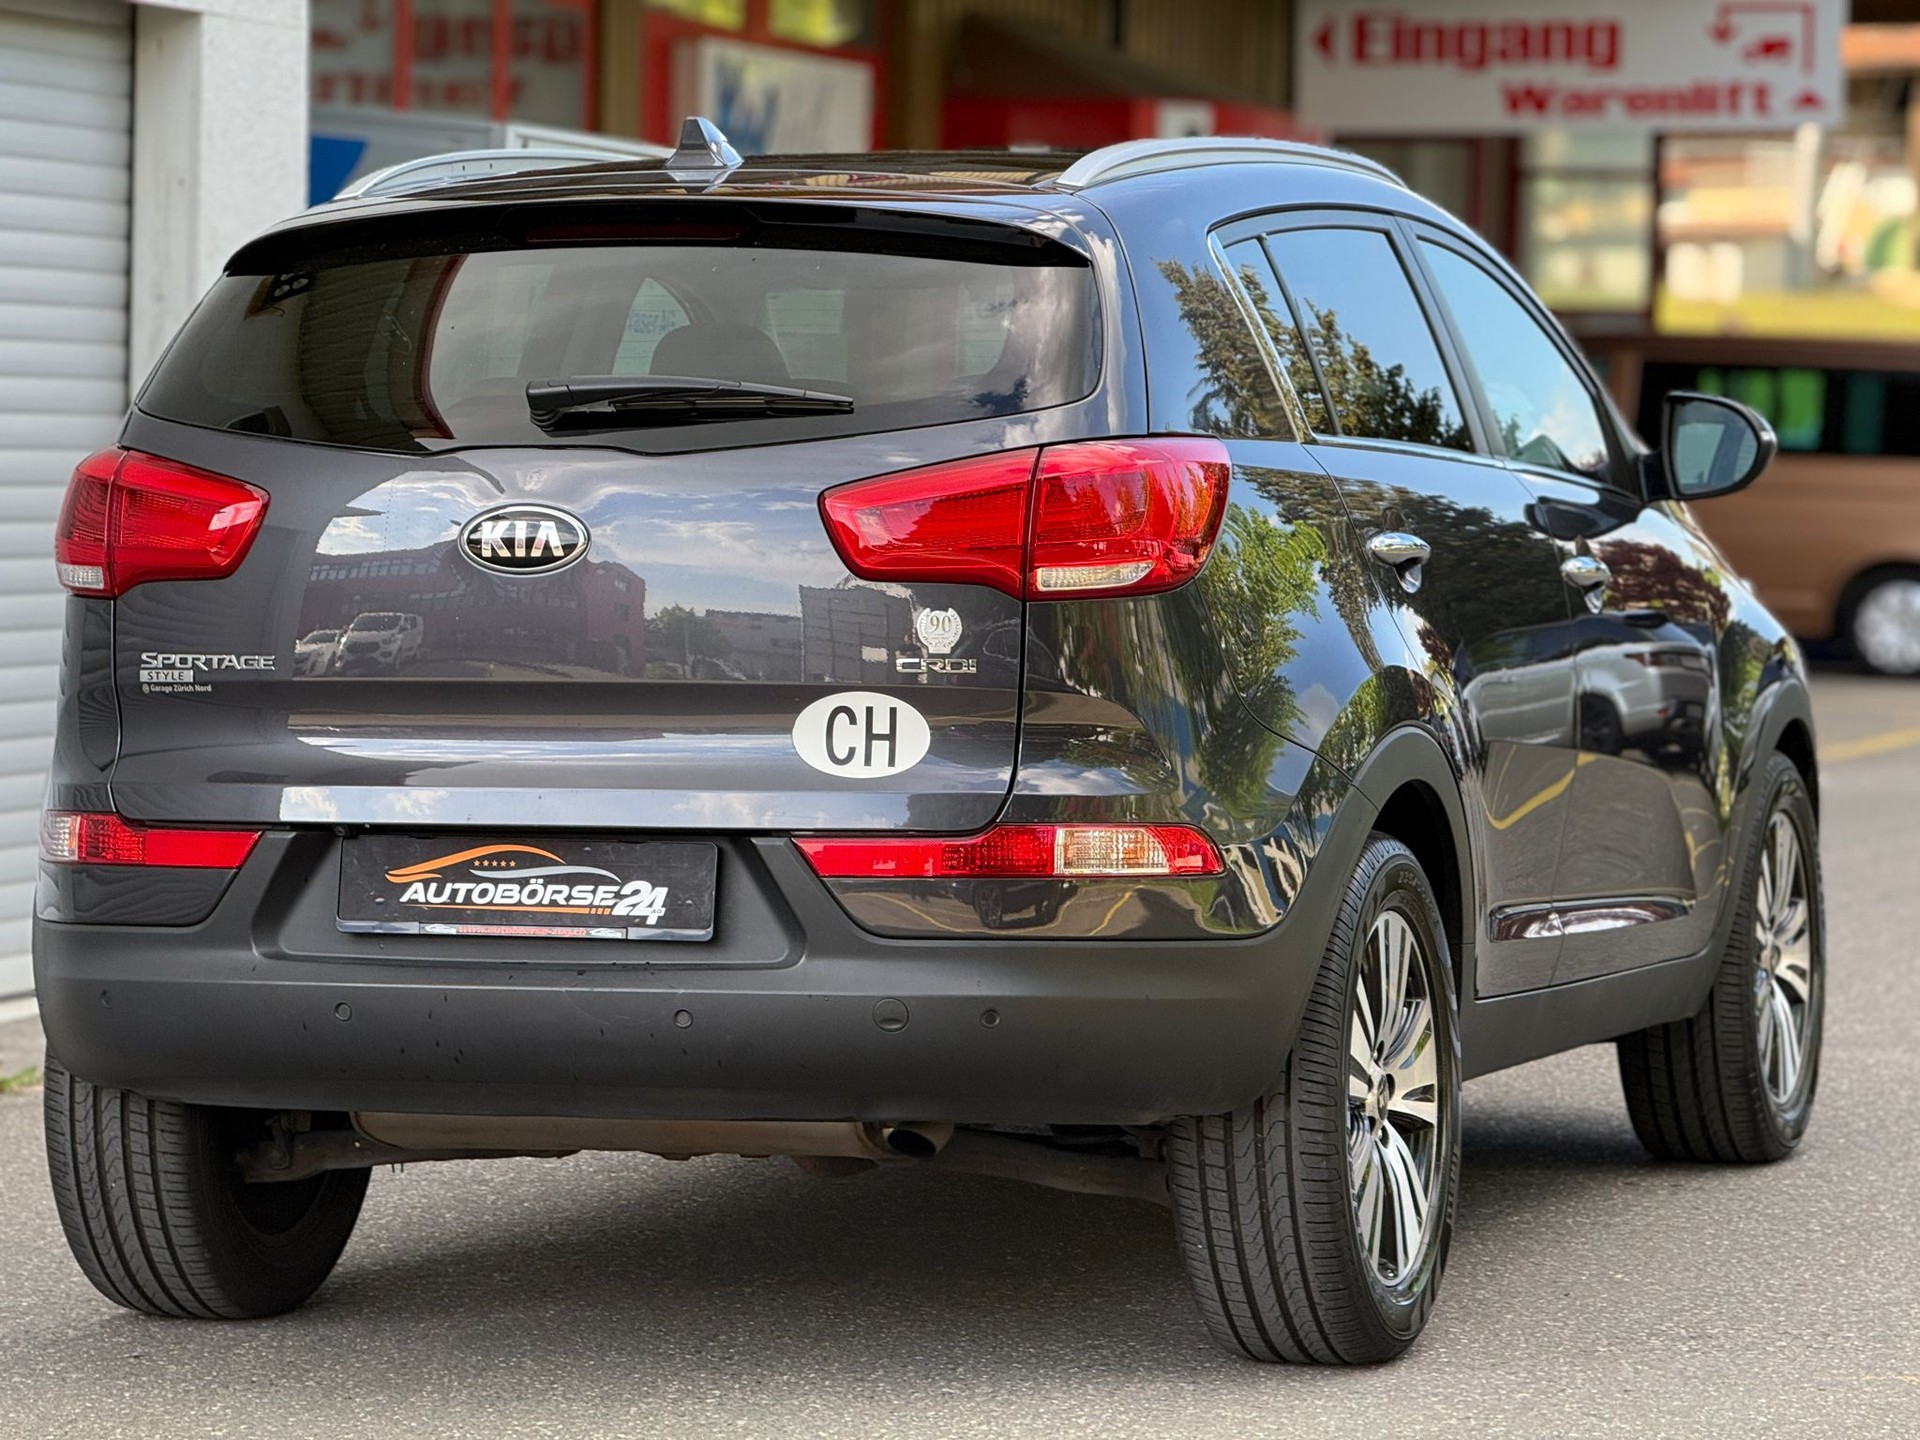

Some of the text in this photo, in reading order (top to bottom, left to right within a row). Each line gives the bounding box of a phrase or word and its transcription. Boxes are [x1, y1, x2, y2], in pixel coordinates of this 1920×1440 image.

[1352, 15, 1622, 71] Eingang
[1502, 81, 1770, 118] Warenlift
[480, 520, 565, 558] KIA
[930, 615, 951, 633] 90
[141, 652, 275, 671] SPORTAGE
[147, 671, 185, 681] STYLE
[150, 683, 213, 694] Garage Zürich Nord
[825, 705, 898, 768] CH
